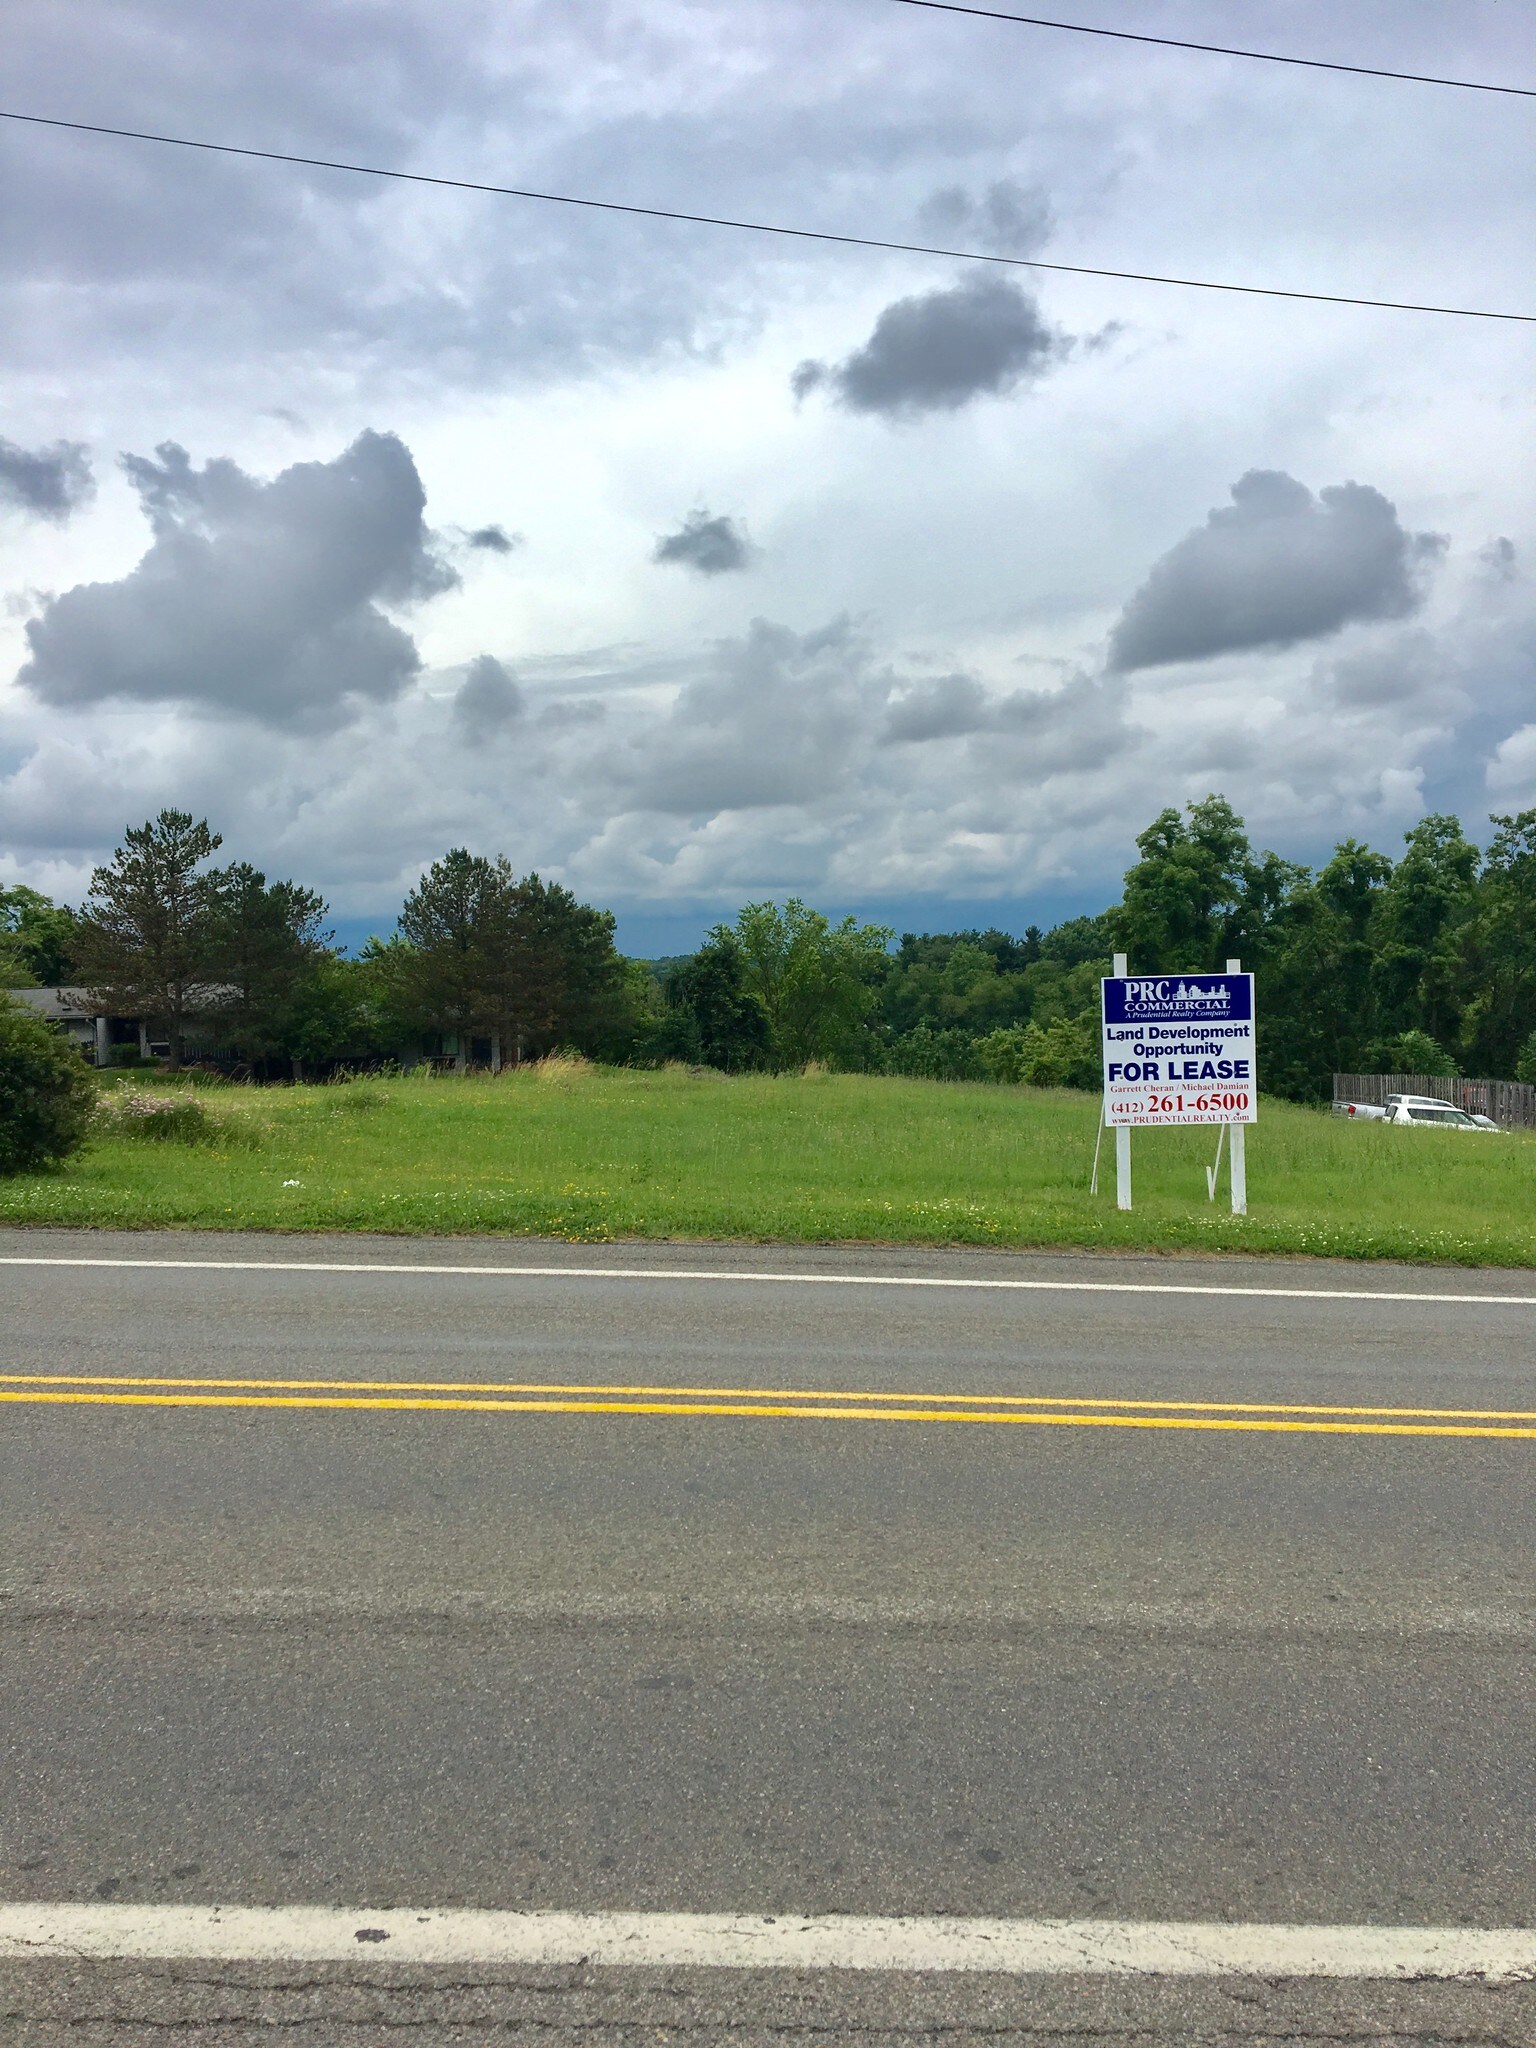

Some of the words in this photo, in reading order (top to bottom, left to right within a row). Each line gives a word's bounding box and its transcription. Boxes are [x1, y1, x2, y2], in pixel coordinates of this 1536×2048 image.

[1124, 981, 1170, 1002] PRC
[1124, 1000, 1231, 1012] COMMERCIAL
[1132, 1011, 1171, 1019] Prudential
[1172, 1010, 1195, 1019] Realty
[1196, 1010, 1231, 1018] Company
[1107, 1027, 1144, 1041] Land
[1149, 1025, 1250, 1040] Development
[1133, 1042, 1224, 1058] Opportunity
[1108, 1062, 1160, 1081] FOR
[1168, 1060, 1250, 1081] LEASE
[1110, 1084, 1141, 1093] Garrett
[1143, 1084, 1174, 1092] Cheran
[1181, 1083, 1214, 1092] Michael
[1216, 1082, 1249, 1090] Damian
[1111, 1101, 1144, 1114] (412)
[1148, 1092, 1249, 1113] 261-6500
[1112, 1114, 1250, 1124] www.PRUDENTIALREALTY.com
